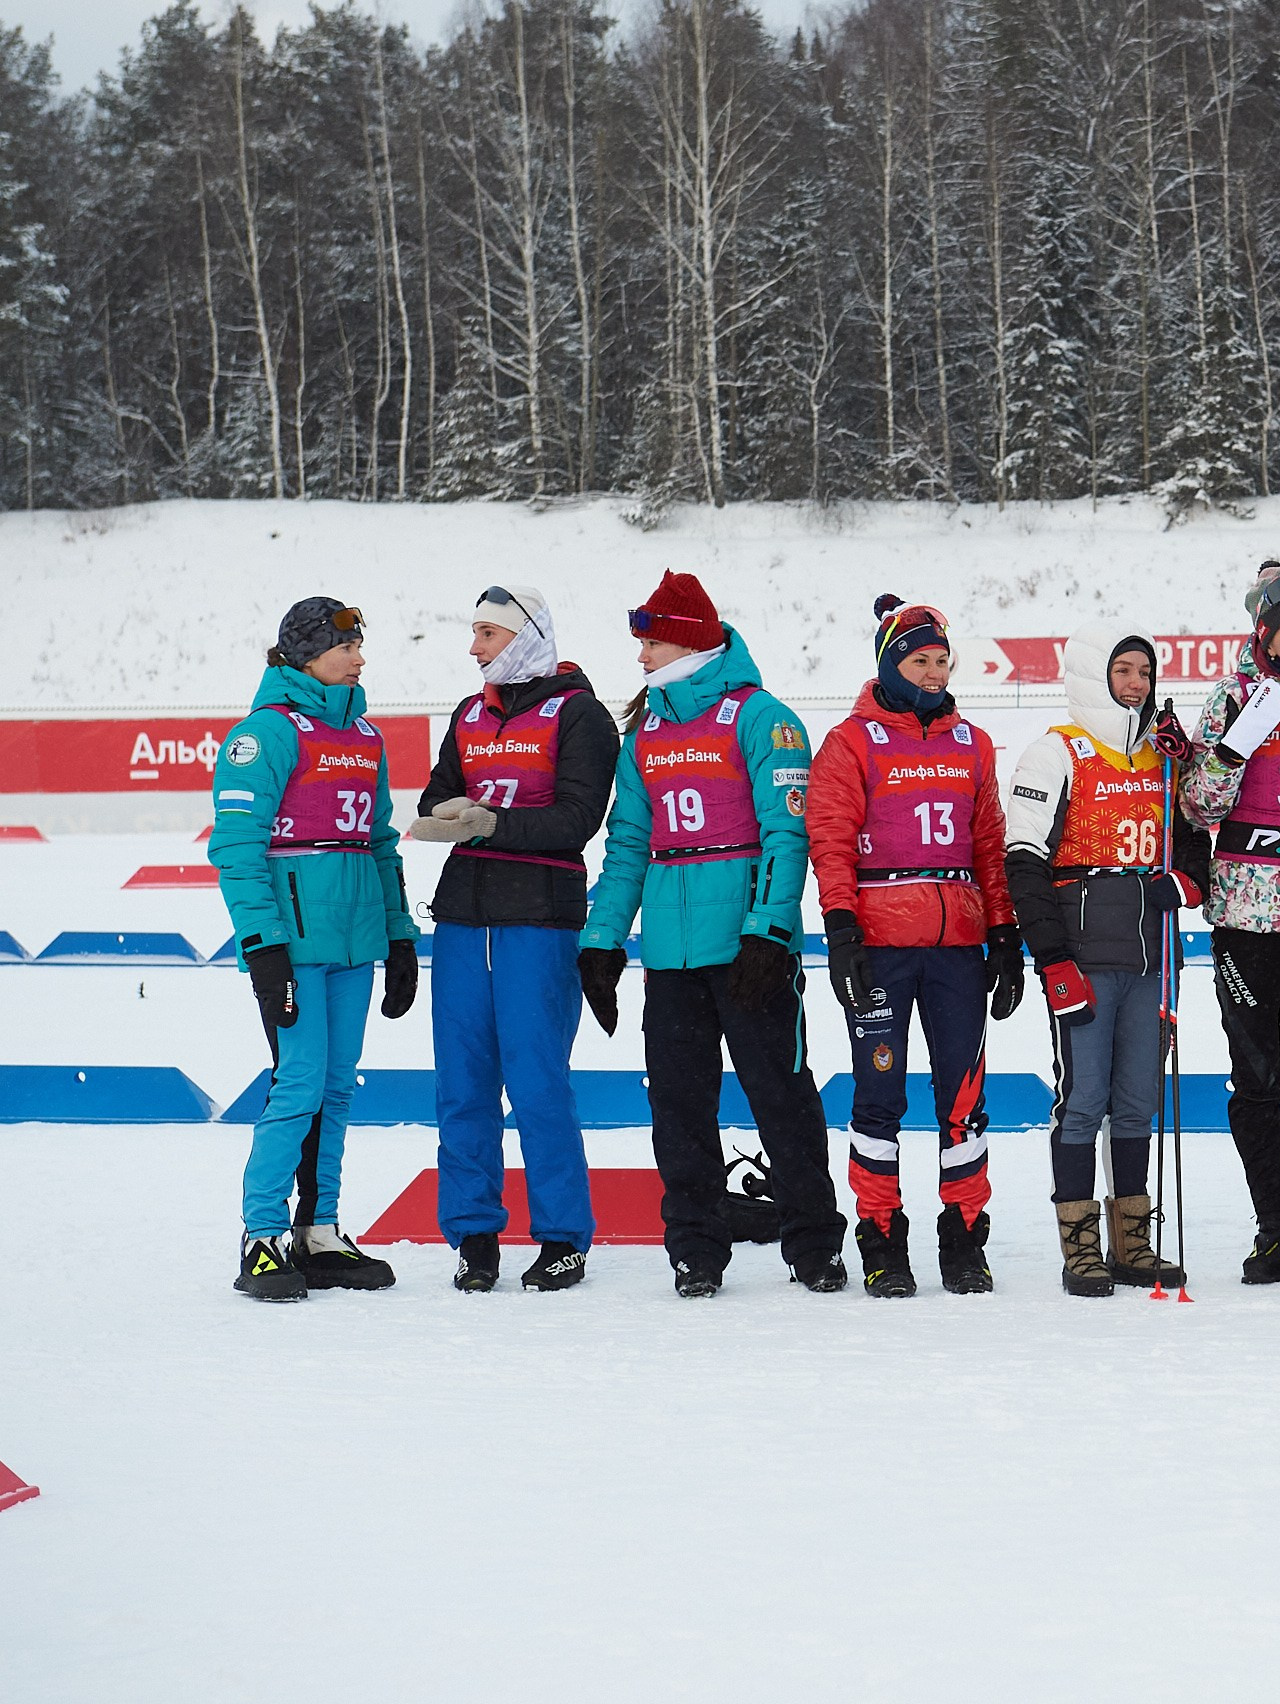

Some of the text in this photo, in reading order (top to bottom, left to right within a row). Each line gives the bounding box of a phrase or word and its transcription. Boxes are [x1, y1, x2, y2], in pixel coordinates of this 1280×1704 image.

[130, 732, 222, 779] Альф
[317, 753, 378, 771] Альфа Банк
[464, 740, 541, 762] Альфа Банк
[645, 749, 723, 773] Альфа Банк
[887, 764, 970, 784] Альфа Банк
[1094, 778, 1141, 800] Альфа
[1142, 778, 1164, 792] Бан
[476, 778, 519, 809] 27
[661, 788, 706, 833] 19
[335, 790, 373, 833] 32
[914, 801, 955, 846] 13
[1117, 819, 1157, 864] 36
[1220, 964, 1243, 1004] ОБЛАСТЬ
[1222, 951, 1258, 1008] ТЮМЕНСКАЯ
[545, 1252, 586, 1276] salom
